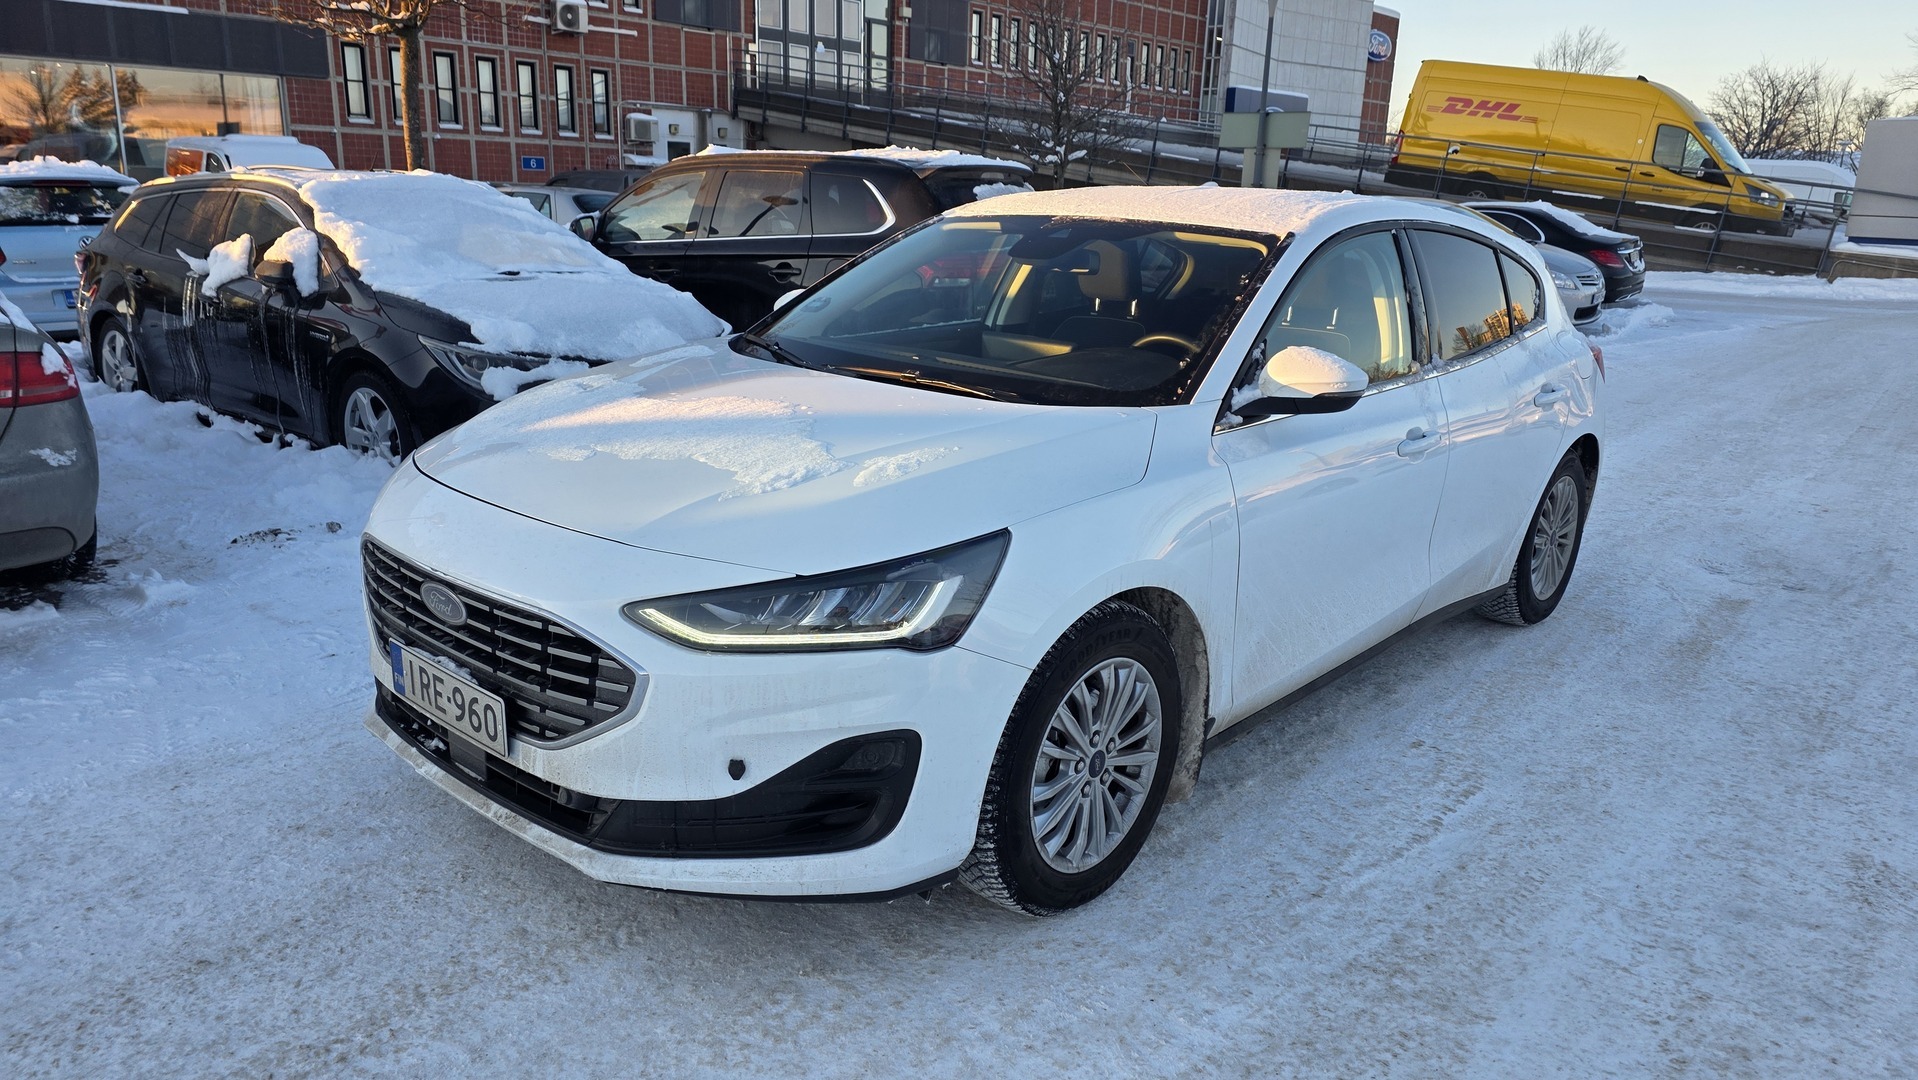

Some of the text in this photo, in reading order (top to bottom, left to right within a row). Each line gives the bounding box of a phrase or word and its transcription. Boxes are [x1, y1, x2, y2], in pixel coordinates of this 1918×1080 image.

[1369, 34, 1387, 56] Ford
[1441, 96, 1522, 122] DHL
[530, 158, 537, 169] 6
[430, 591, 452, 616] Ford
[394, 671, 405, 687] FIN
[409, 660, 498, 742] IRE-960
